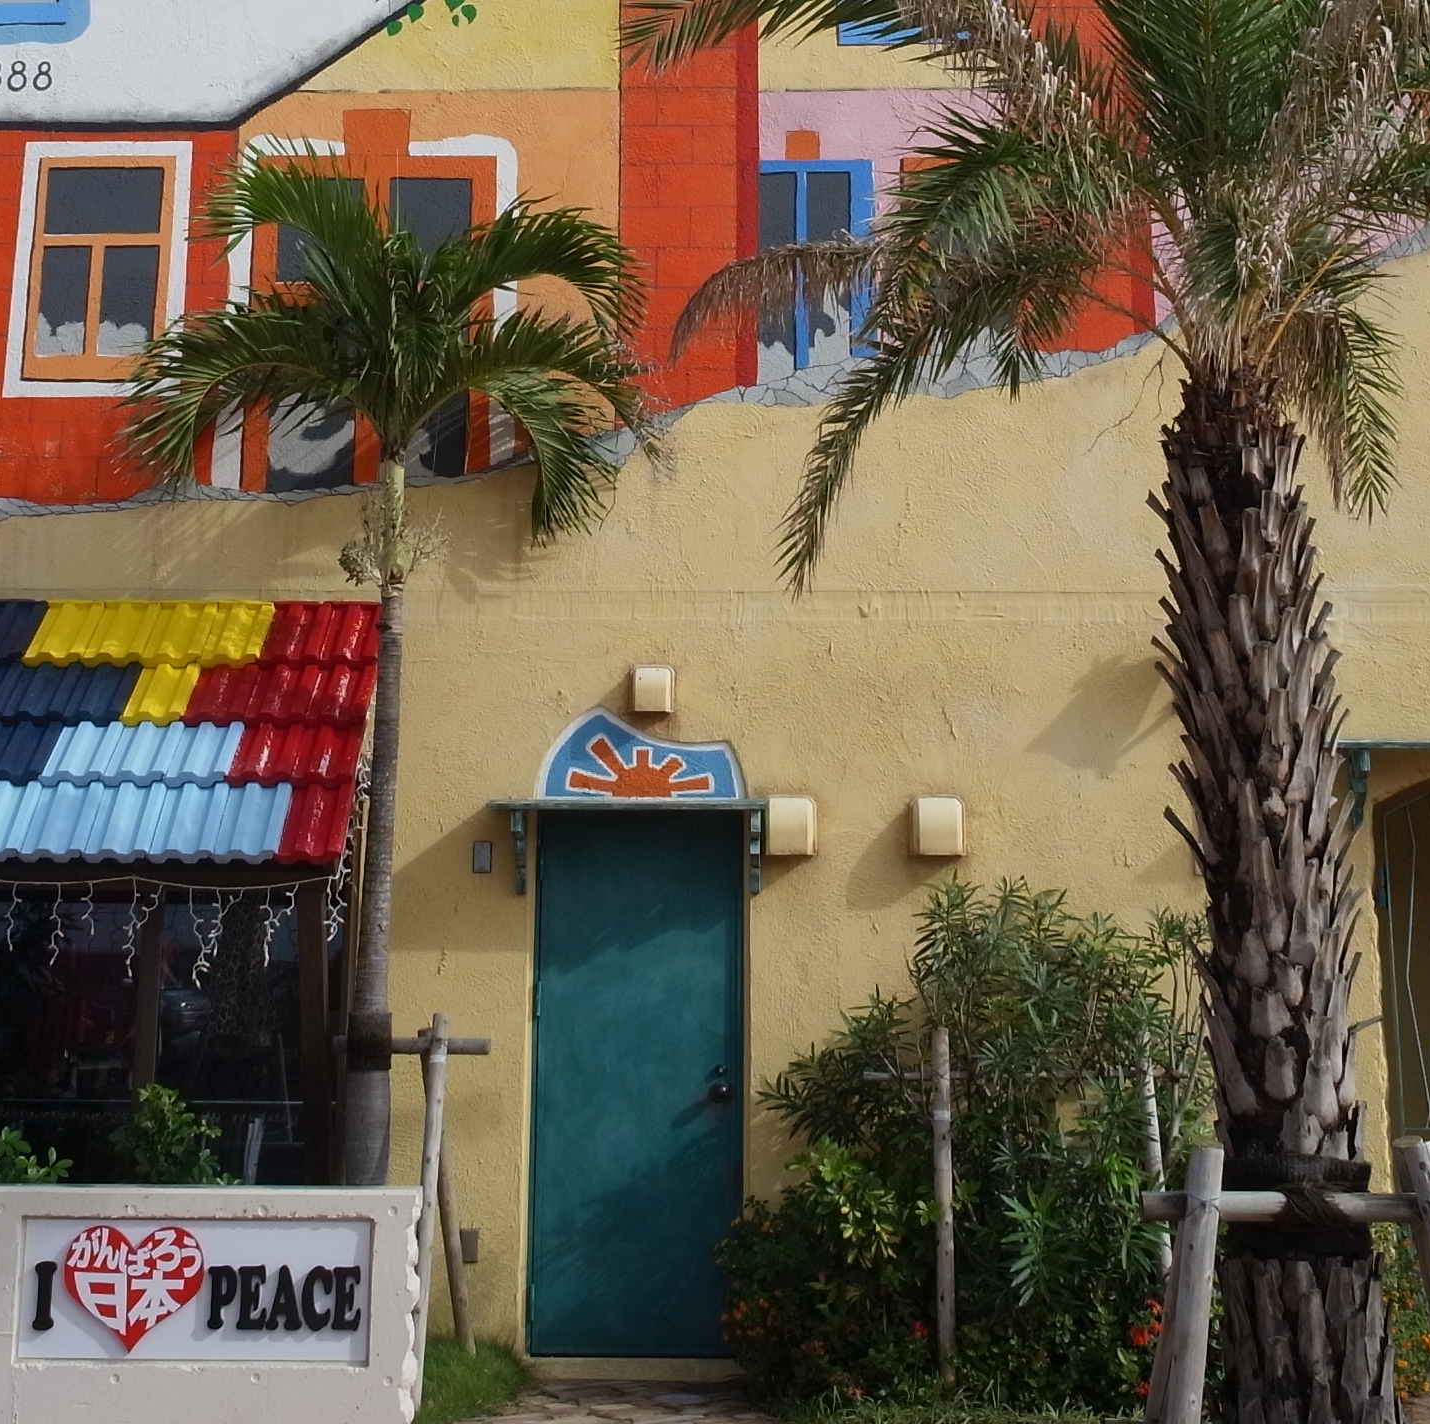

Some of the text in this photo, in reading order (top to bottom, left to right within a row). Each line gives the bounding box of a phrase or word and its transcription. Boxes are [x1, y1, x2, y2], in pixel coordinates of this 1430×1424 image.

[67, 1227, 203, 1278] がんばろう
[32, 1261, 361, 1331] I PEACE
[74, 1271, 185, 1336] 日本
